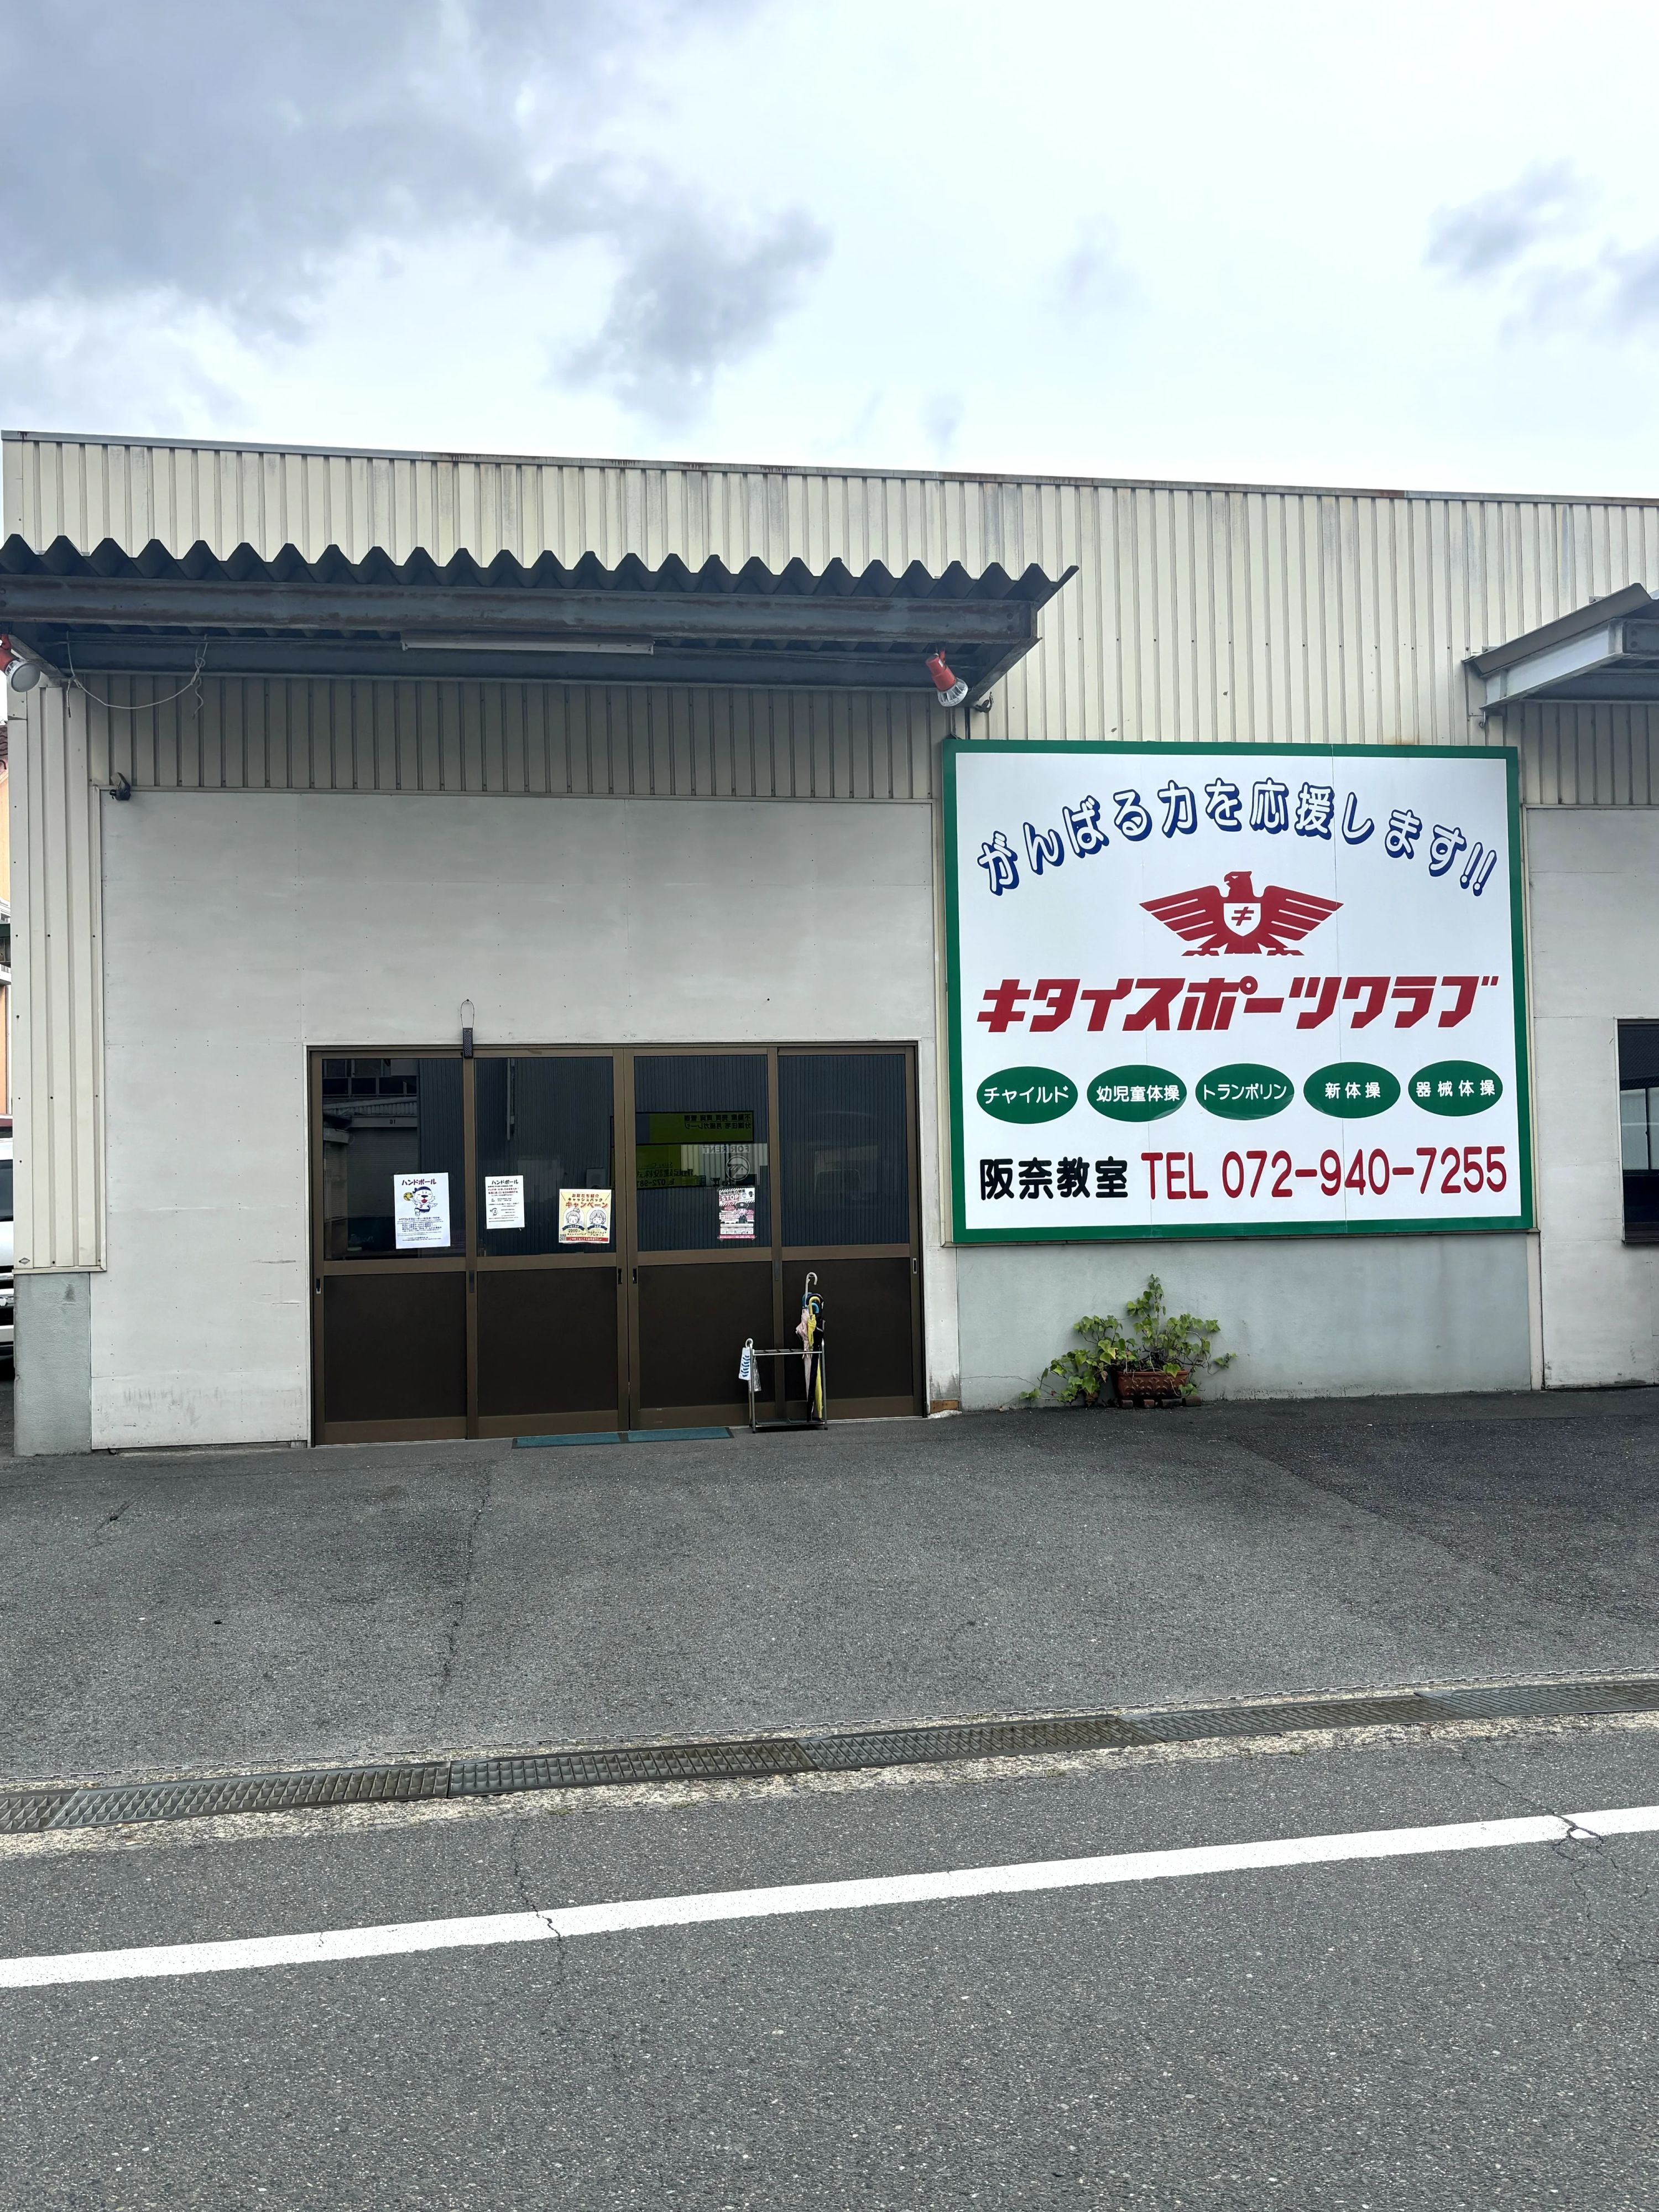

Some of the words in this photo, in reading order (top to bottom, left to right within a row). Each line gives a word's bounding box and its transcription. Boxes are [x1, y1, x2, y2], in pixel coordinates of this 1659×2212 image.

[977, 975, 1499, 1033] キタイスポーツクラブ
[984, 1085, 1069, 1104] チャイルド
[1095, 1084, 1180, 1103] 幼児童体操
[1203, 1082, 1287, 1100] トランポリン
[1324, 1082, 1381, 1099] 新体操
[1416, 1079, 1496, 1098] 器械体操
[979, 1156, 1128, 1201] 阪奈教室
[1141, 1152, 1208, 1199] TEL
[1222, 1146, 1506, 1198] 072-940-7255
